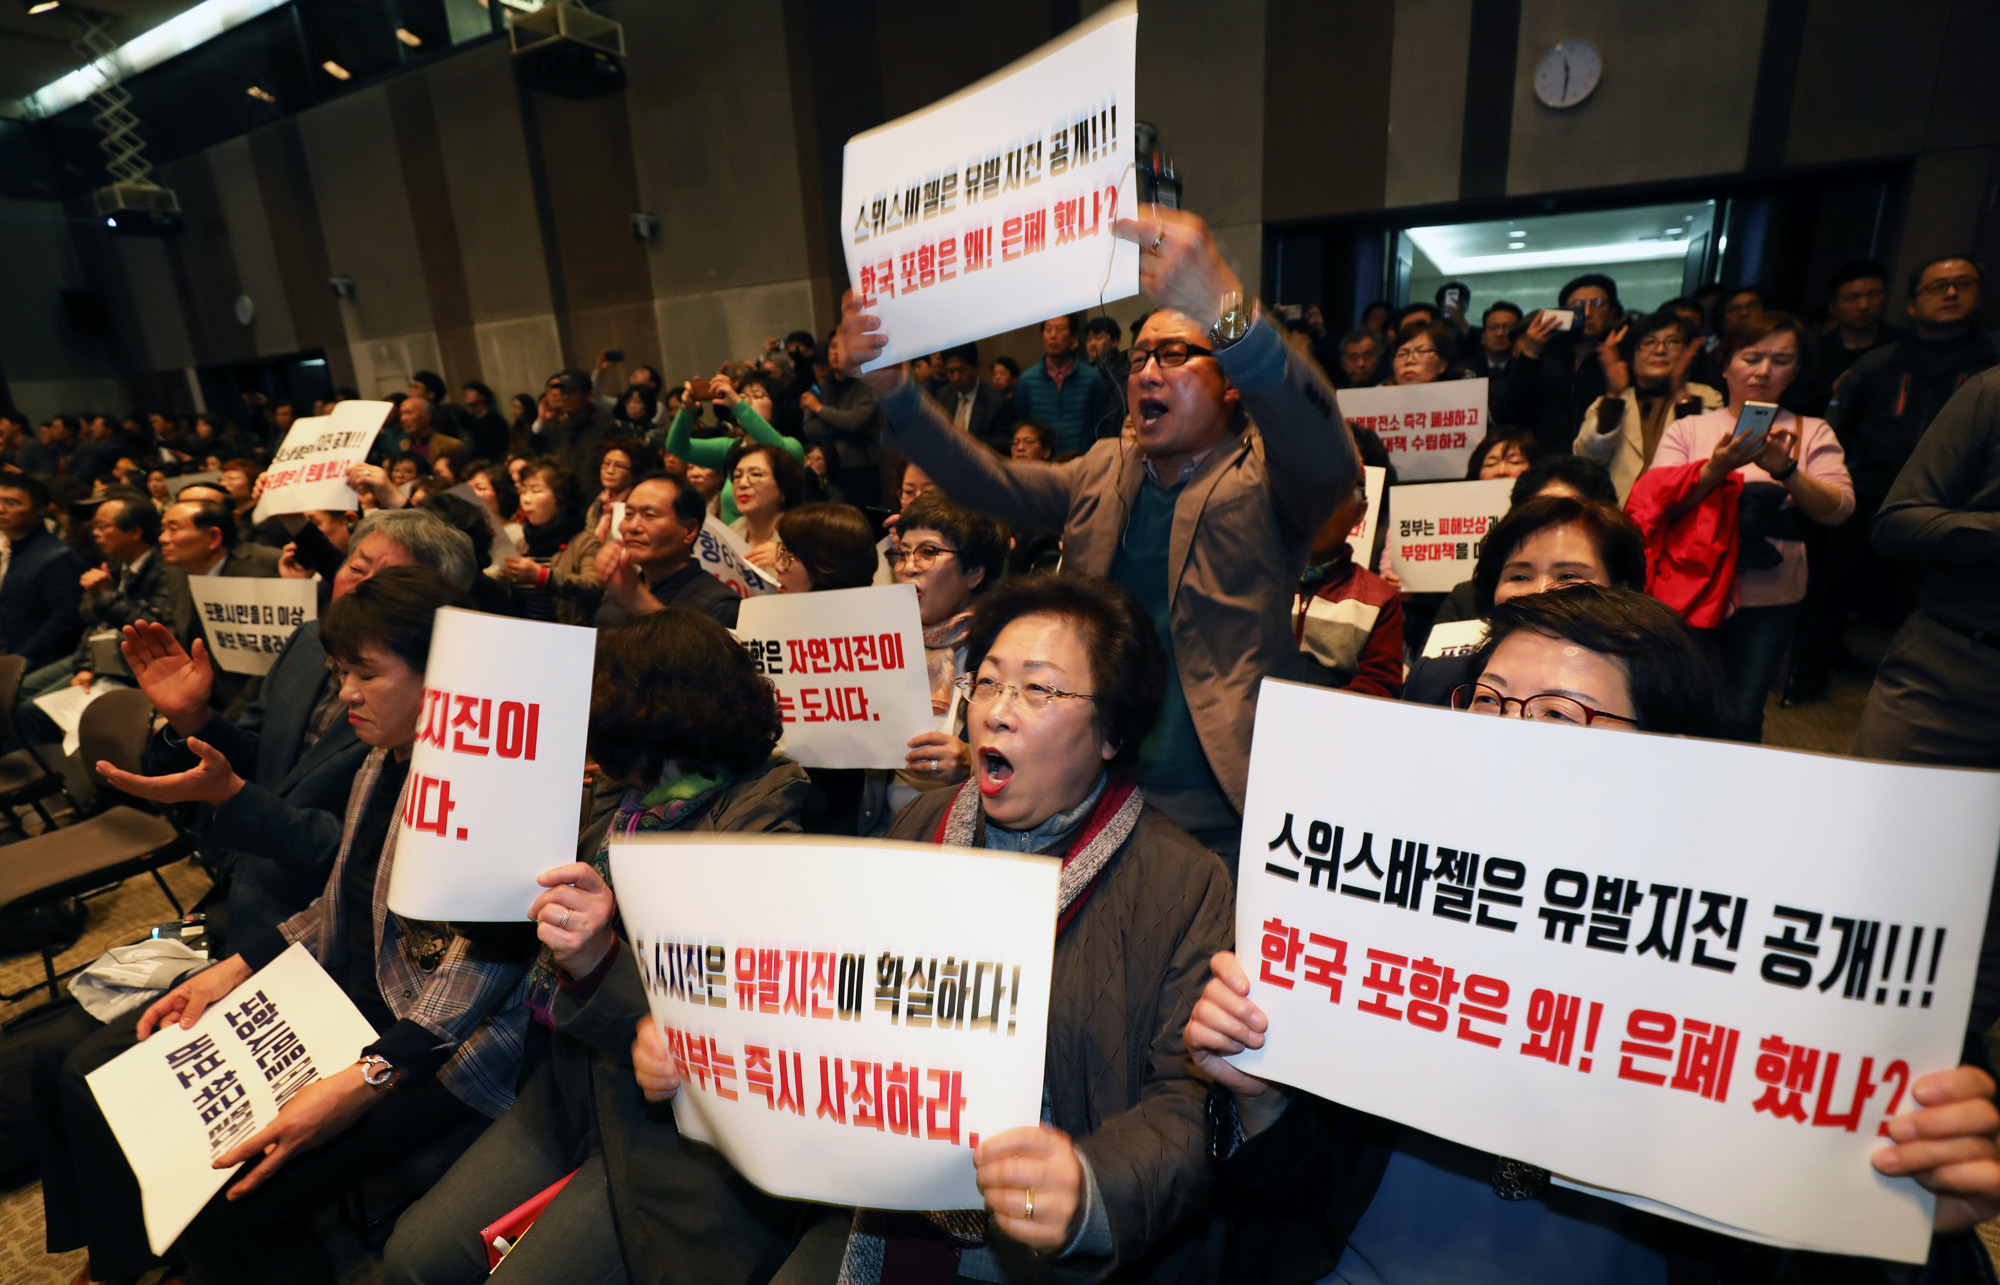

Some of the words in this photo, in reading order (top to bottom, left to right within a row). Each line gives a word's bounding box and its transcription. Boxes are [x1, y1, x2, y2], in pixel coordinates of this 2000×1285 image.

[854, 172, 958, 245] 스위스바젤은
[964, 138, 1042, 206] 유발지진
[1049, 104, 1117, 178] 공개!!!
[860, 258, 896, 309] 한국
[900, 237, 957, 296] 포항은
[964, 226, 993, 275] 왜!
[1001, 208, 1046, 263] 은폐
[1054, 184, 1117, 247] 했나?
[1345, 412, 1401, 432] 열발전소
[1404, 412, 1427, 429] 즉각
[1430, 408, 1479, 429] 폐쇄하고
[1411, 432, 1468, 451] 수립하라
[1400, 519, 1435, 537] 정부는
[1401, 542, 1469, 562] 부양대책을
[204, 602, 260, 625] 포항시민을
[263, 606, 274, 625] 더
[278, 605, 304, 626] 이상
[741, 639, 784, 675] 항은
[786, 632, 905, 675] 자연지진이
[800, 686, 880, 723] 도시다.
[1264, 812, 1527, 933] 스위스바젤은
[1538, 867, 1748, 974] 유발지진
[1759, 904, 1947, 1009] 공개!!!
[734, 947, 866, 1023] 유발지진이
[874, 951, 1021, 1036] 확실하다!
[224, 989, 306, 1082] 포항시민을
[275, 1066, 323, 1112] 이
[1259, 917, 1348, 1005] 한국
[1357, 947, 1510, 1049] 포항은
[1520, 988, 1604, 1074] 왜!
[1617, 1008, 1740, 1103] 은폐
[1752, 1034, 1910, 1137] 했나?
[165, 1033, 226, 1089] 바보
[664, 1025, 738, 1102] 정부는
[743, 1043, 805, 1117] 즉시
[815, 1055, 979, 1149] 사죄하라.
[192, 1070, 247, 1125] 취급
